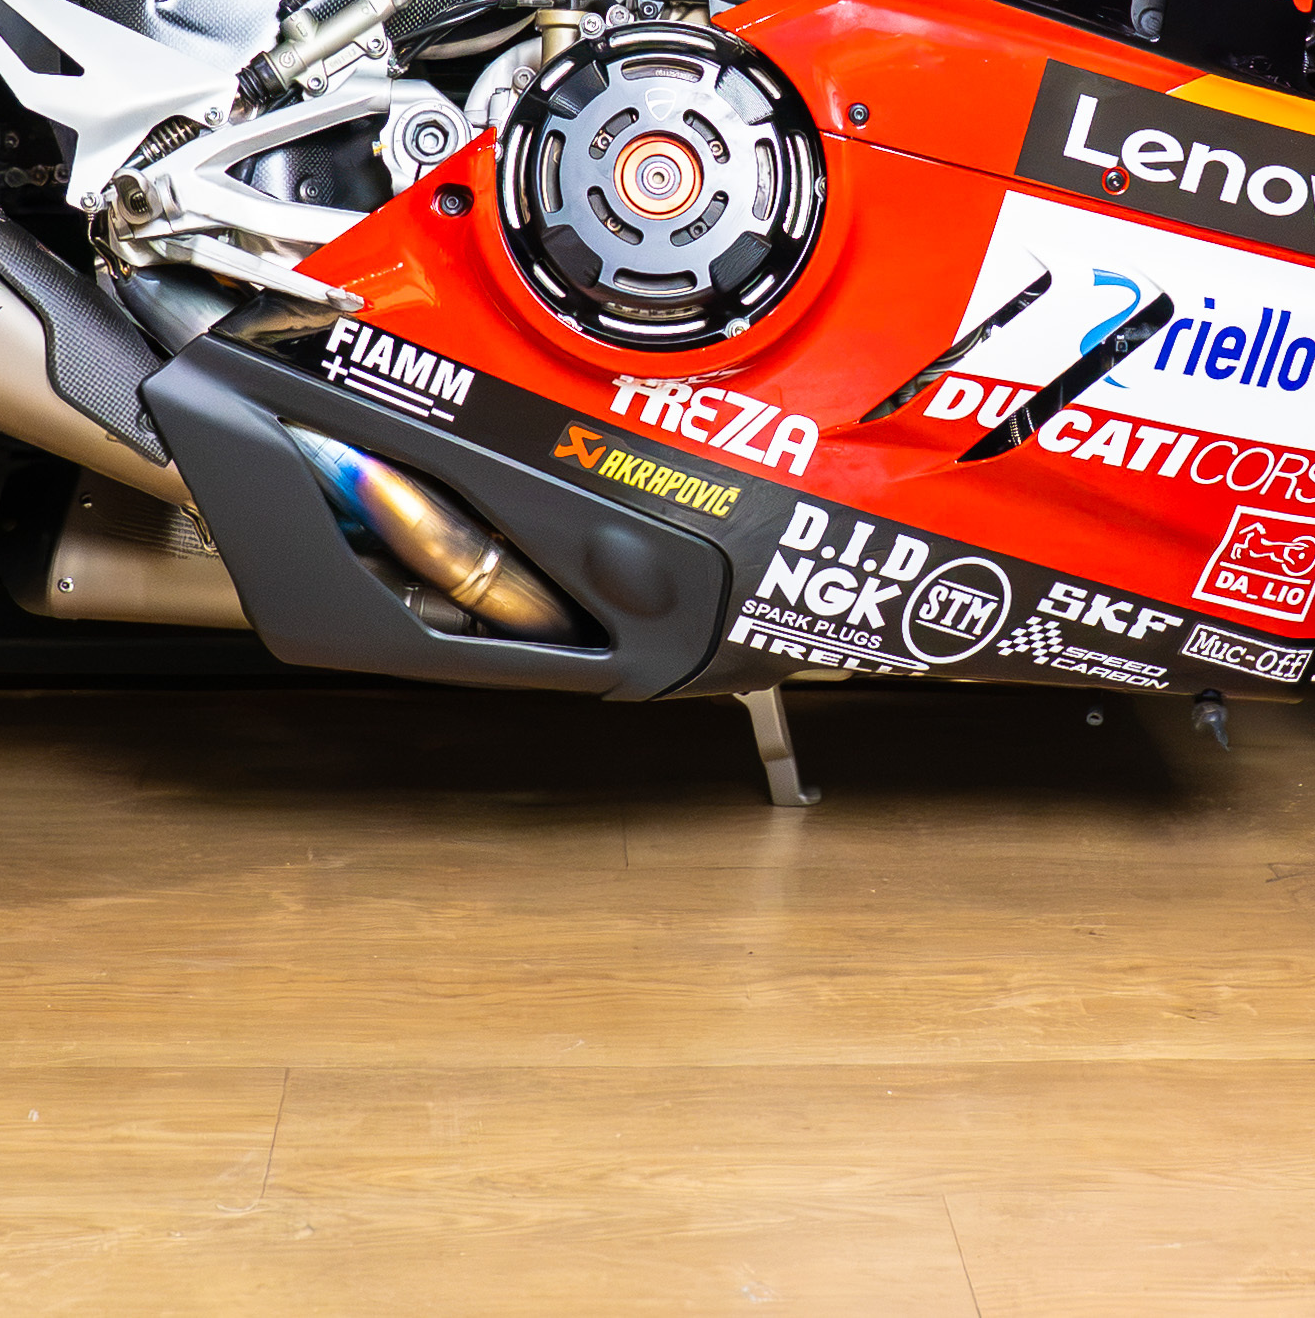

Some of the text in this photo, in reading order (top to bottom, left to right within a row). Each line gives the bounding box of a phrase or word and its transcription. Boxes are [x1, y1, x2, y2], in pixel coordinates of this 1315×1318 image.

[325, 316, 476, 407] FIAMM
[922, 375, 1199, 479] DUCATI
[778, 501, 930, 582] D.I.D
[755, 549, 903, 630] NGK
[918, 583, 999, 637] STM
[1036, 581, 1184, 639] SKF
[727, 615, 930, 676] PIREL
[742, 599, 883, 649] SPARK PLUGS
[1050, 658, 1171, 691] CARBON
[1061, 645, 1168, 678] SPEED
